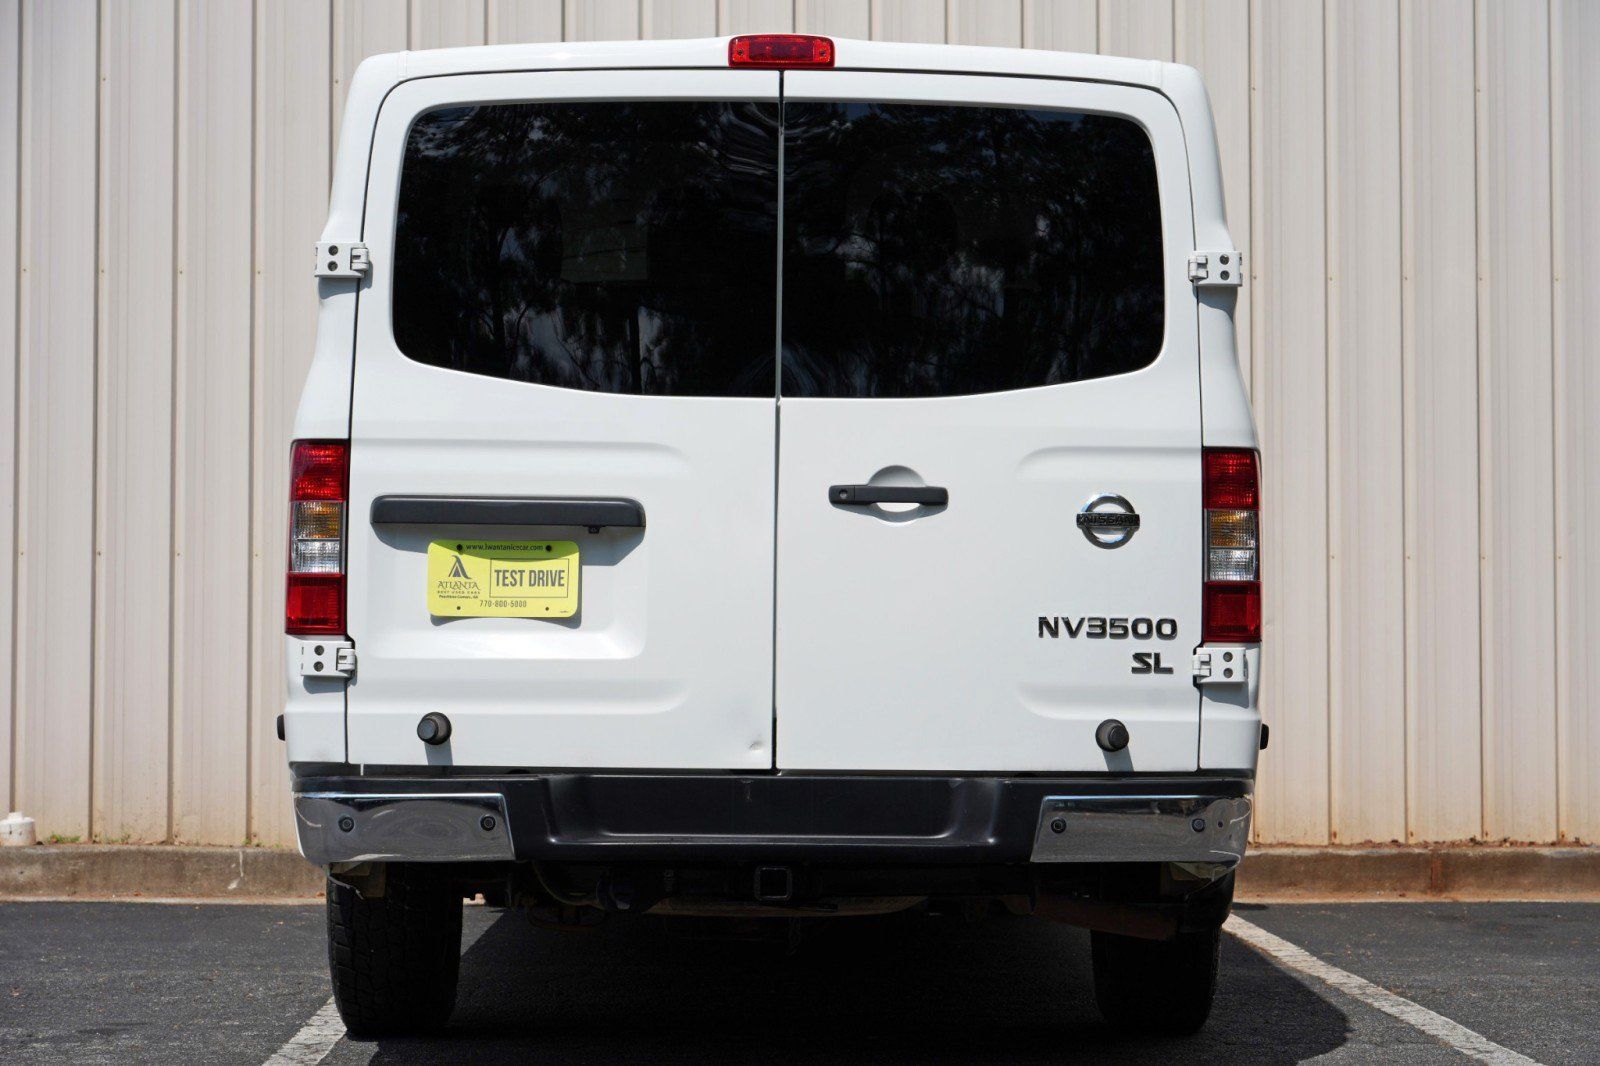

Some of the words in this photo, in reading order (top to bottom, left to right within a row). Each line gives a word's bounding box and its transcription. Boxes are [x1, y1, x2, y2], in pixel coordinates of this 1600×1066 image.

[1080, 514, 1135, 525] NISSAN
[437, 580, 480, 590] ATLANTA
[494, 569, 525, 587] TEST
[529, 569, 565, 587] DRIVE
[1038, 616, 1178, 641] NV3500
[1131, 652, 1174, 674] SL
